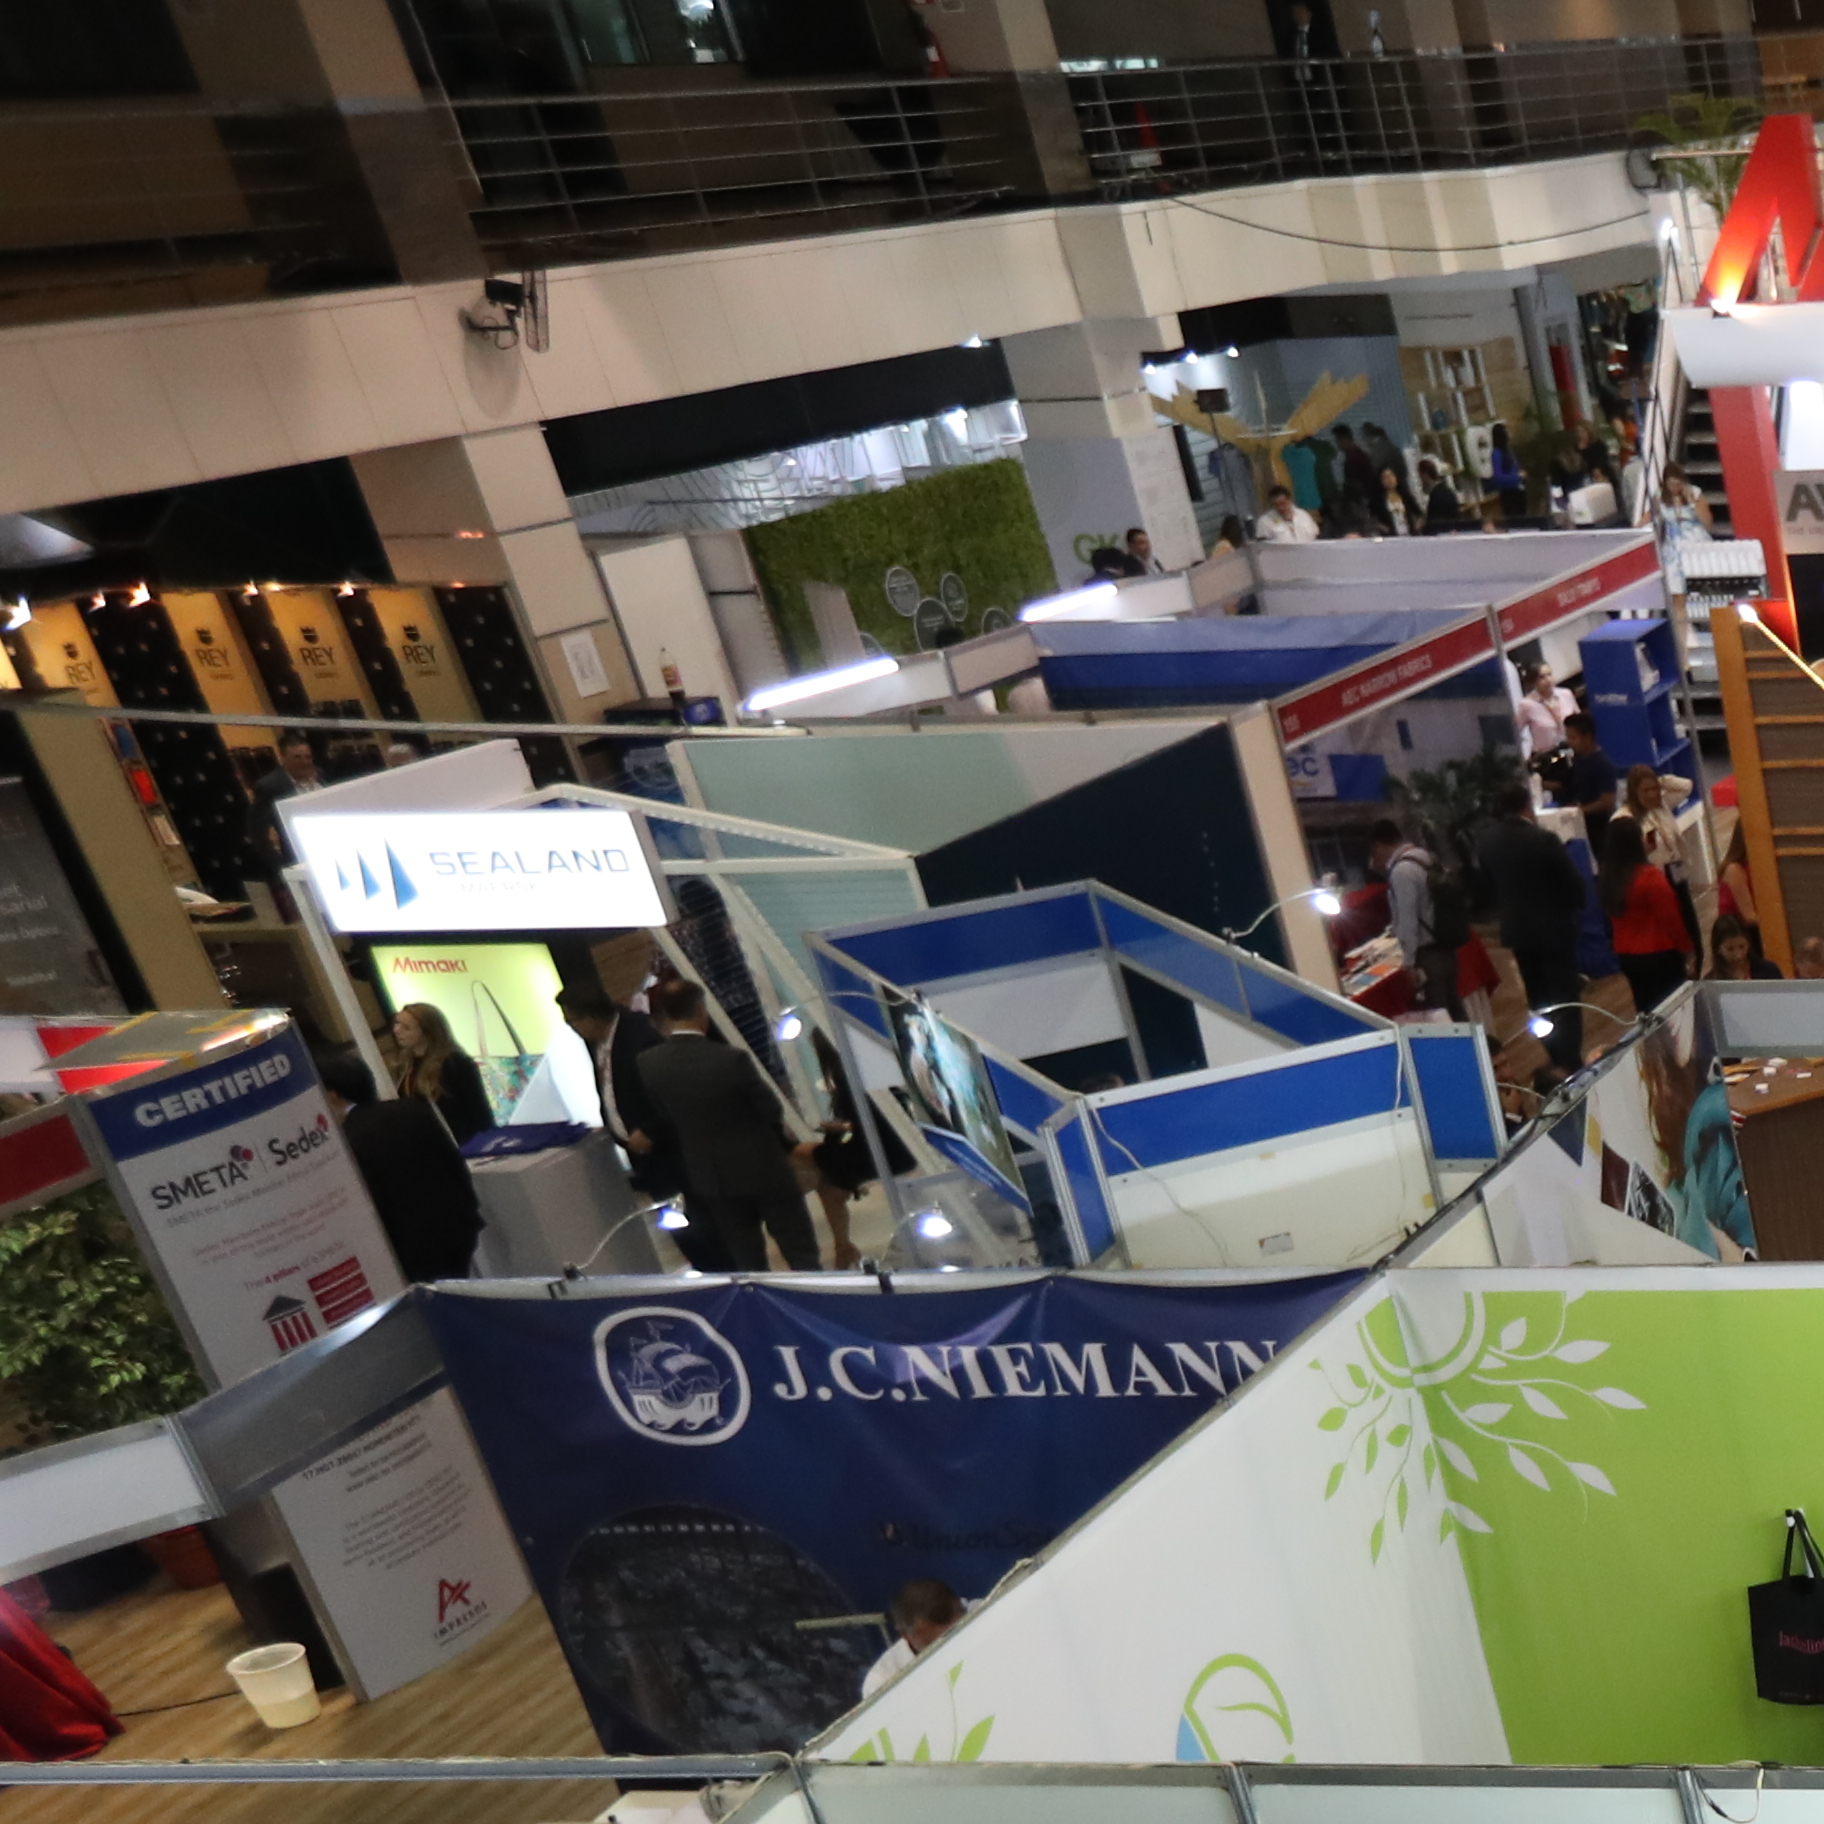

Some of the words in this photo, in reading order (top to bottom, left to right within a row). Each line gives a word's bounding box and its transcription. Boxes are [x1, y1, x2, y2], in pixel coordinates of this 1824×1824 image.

[195, 647, 231, 669] REY
[299, 646, 336, 667] REY
[401, 643, 437, 665] REY
[64, 660, 97, 685] REY
[429, 848, 630, 876] SEALAND
[392, 955, 469, 974] Mimaki
[133, 1053, 293, 1128] CERTIFIED
[267, 1124, 329, 1167] Sedex
[151, 1160, 250, 1211] SMETA
[772, 1339, 1279, 1402] J.C.NIEMANN
